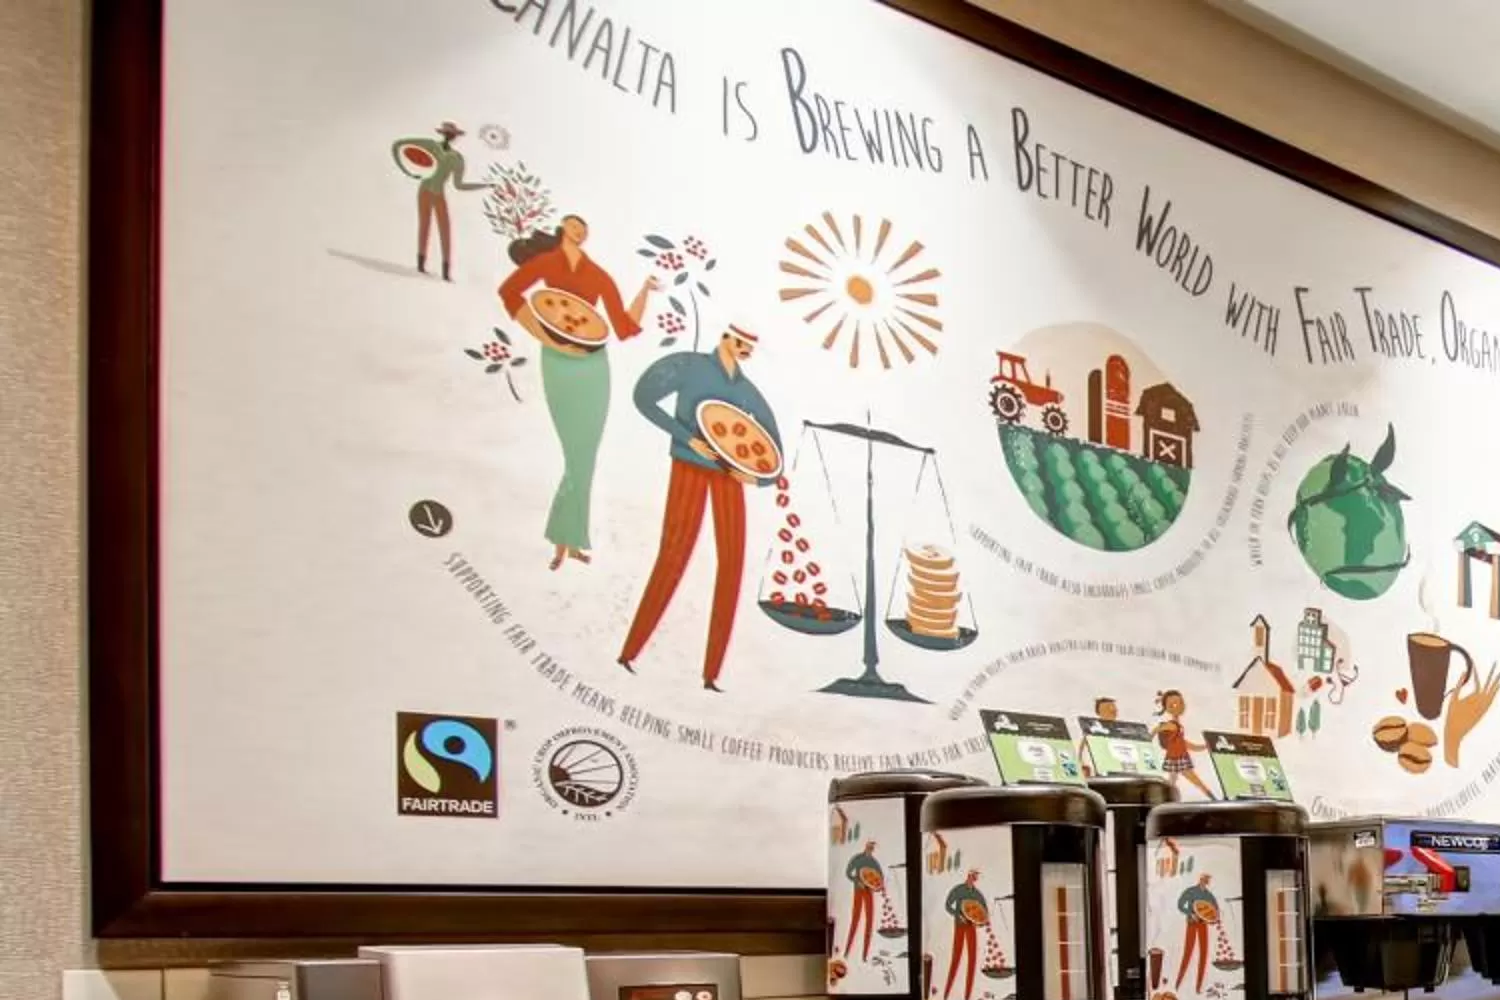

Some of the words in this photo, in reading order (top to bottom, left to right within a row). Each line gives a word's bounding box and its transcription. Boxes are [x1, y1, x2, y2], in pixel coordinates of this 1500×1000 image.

[489, 0, 676, 114] ANALTA
[722, 75, 758, 141] IS
[966, 124, 988, 181] A
[1224, 282, 1280, 357] WITH
[443, 552, 513, 625] SUPPORTING
[502, 623, 537, 656] FAIR
[531, 652, 574, 691] TRADE
[571, 681, 617, 717] MEANS
[619, 704, 672, 740] HELPING
[677, 724, 715, 752] SMALL
[721, 735, 763, 762] COFFEE
[768, 746, 830, 772] PRODUCERS
[402, 797, 493, 814] FAIRTRADE
